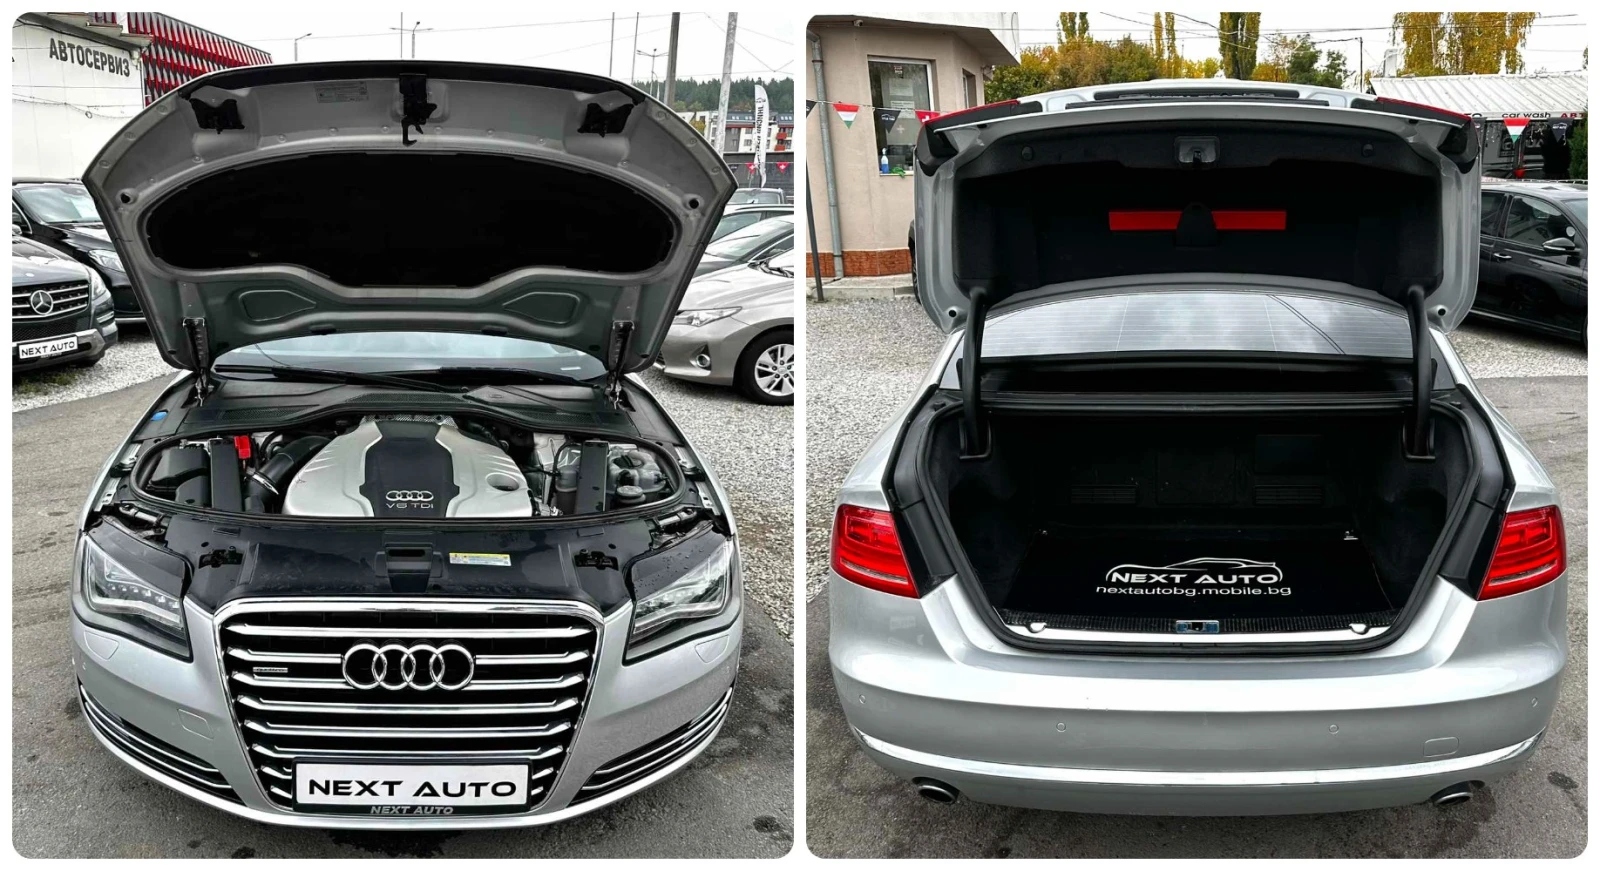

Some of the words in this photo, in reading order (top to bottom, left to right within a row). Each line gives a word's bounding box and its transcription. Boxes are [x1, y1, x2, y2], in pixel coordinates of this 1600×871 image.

[49, 37, 130, 77] АВТОСЕРВИЗ
[1523, 111, 1551, 119] wash
[21, 345, 48, 357] NEXT
[50, 341, 75, 352] AUTO
[1110, 571, 1188, 584] NEXT
[1194, 573, 1279, 584] AUTO
[1095, 586, 1292, 597] nextautobg.mobile.bg
[309, 779, 403, 797] NEXT
[412, 780, 517, 798] AUTO
[370, 805, 410, 815] NEXT
[413, 805, 454, 815] AUTO
